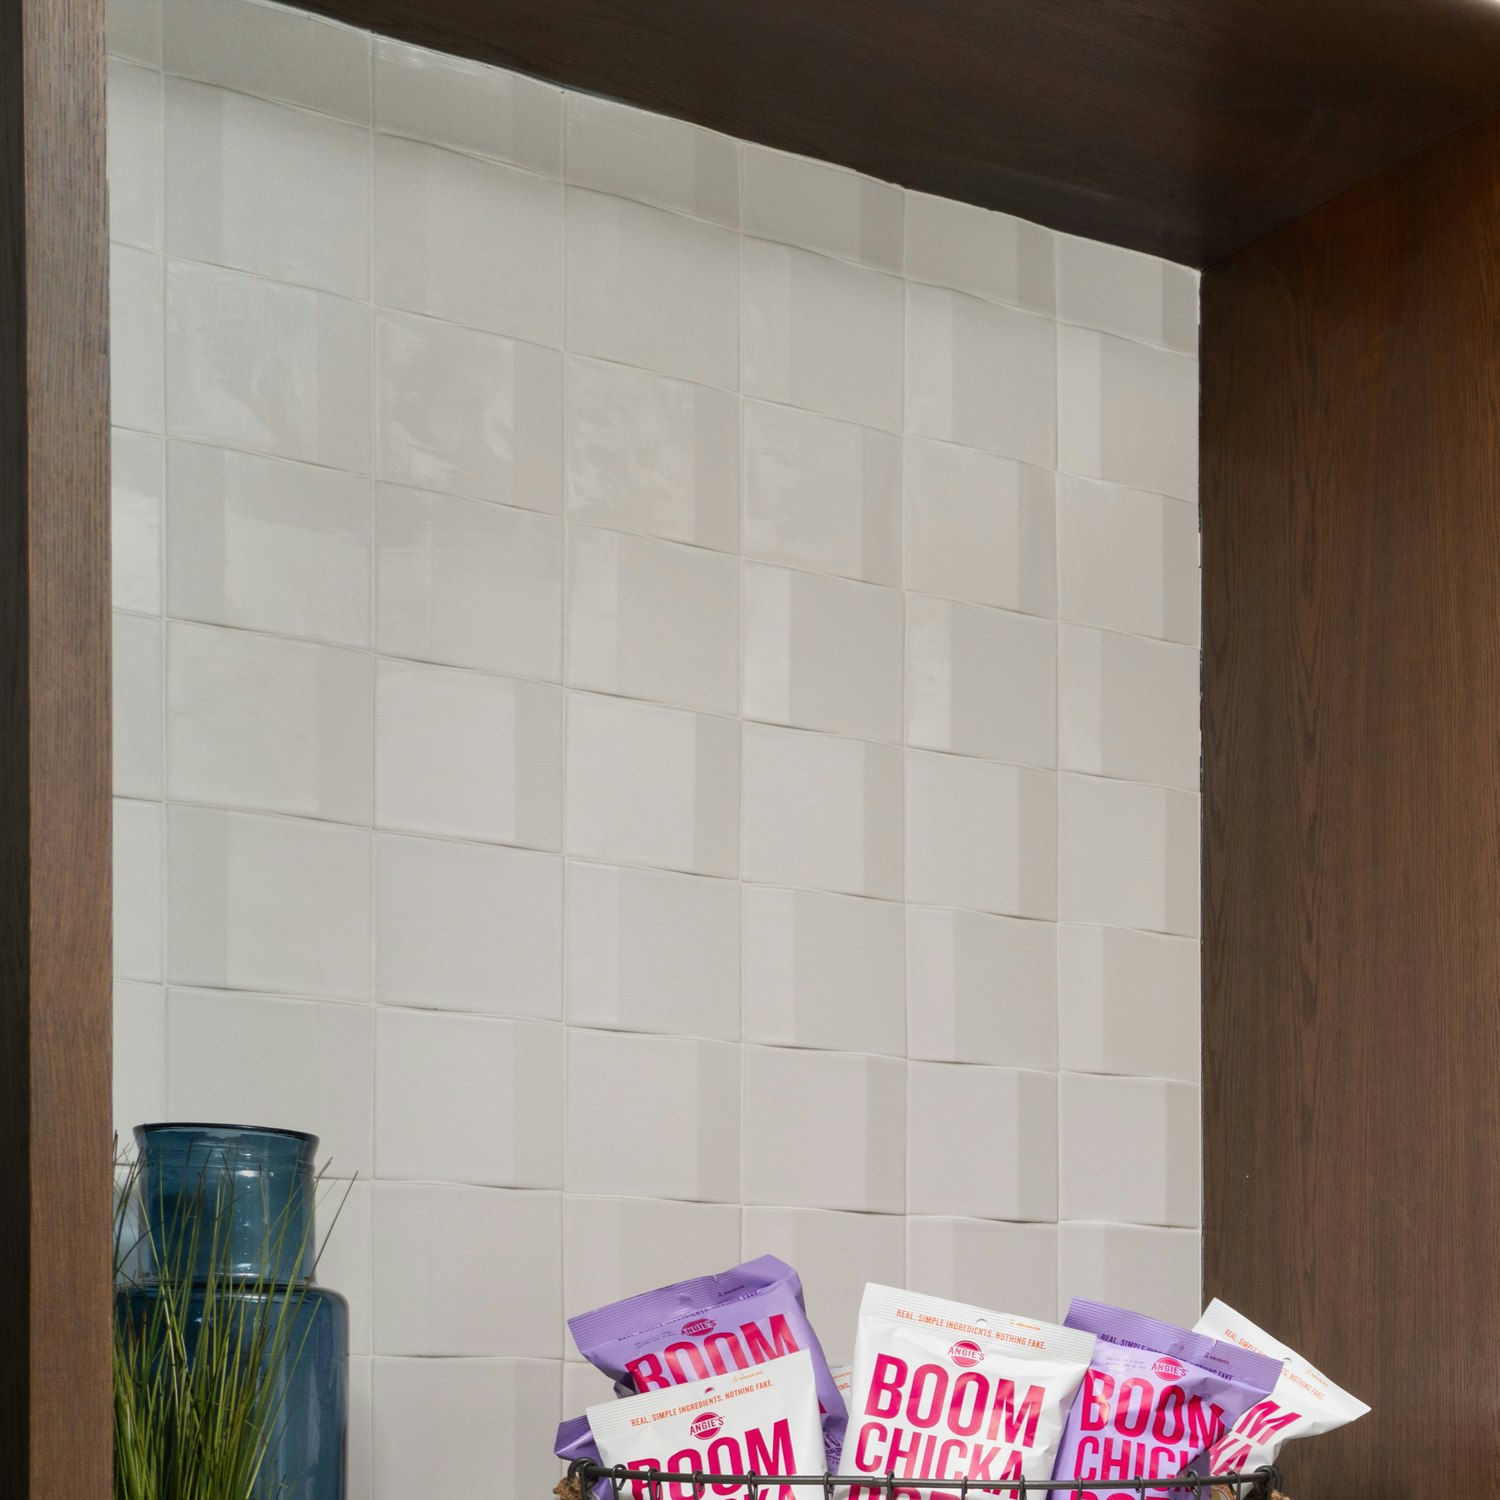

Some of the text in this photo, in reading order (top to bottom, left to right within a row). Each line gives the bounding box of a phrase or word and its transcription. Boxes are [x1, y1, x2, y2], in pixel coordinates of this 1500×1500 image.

[681, 1319, 717, 1335] ANGIE'S
[918, 1315, 945, 1327] SIMPLE
[946, 1321, 994, 1338] INGREDIENTS.
[995, 1332, 1026, 1346] NOTHING
[624, 1314, 800, 1393] BOOM
[947, 1346, 986, 1361] ANGIE'S
[1151, 1362, 1188, 1377] ANGIE'S
[652, 1386, 754, 1422] SIMPLE INGREDIENTS. NOTHING
[864, 1352, 1046, 1449] BOOM
[1080, 1368, 1225, 1451] BOOM
[690, 1417, 724, 1436] ANGIE'S
